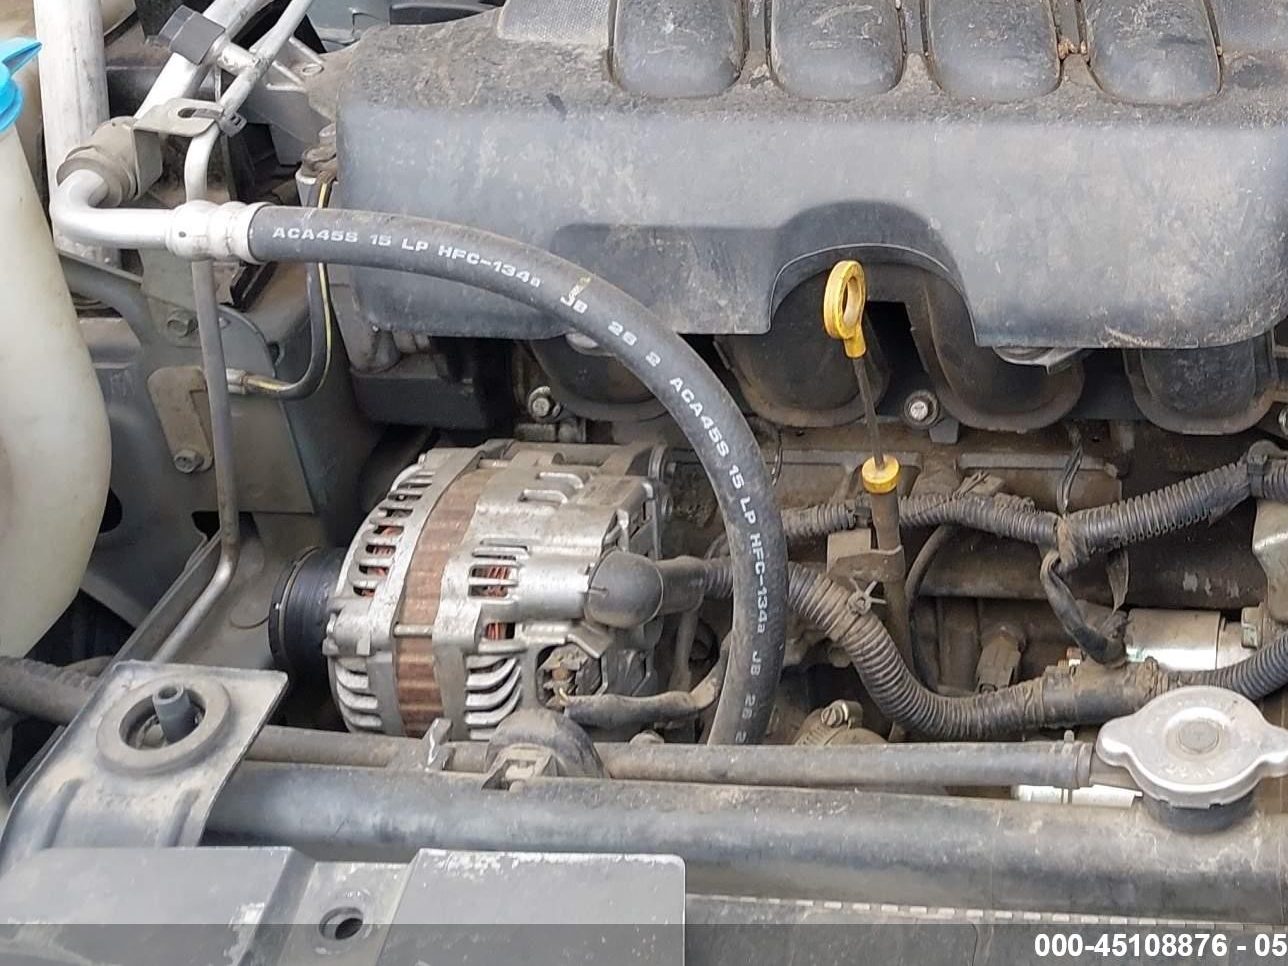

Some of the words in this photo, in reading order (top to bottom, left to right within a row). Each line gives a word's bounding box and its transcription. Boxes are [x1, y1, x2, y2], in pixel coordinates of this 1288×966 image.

[272, 227, 359, 244] ACA45S
[370, 233, 392, 247] 15
[401, 238, 429, 252] LP
[438, 244, 542, 288] HFC-134a
[645, 351, 661, 367] 2
[669, 377, 730, 457] ACA45S
[729, 464, 745, 489] 15
[740, 496, 757, 524] LP
[750, 533, 768, 634] HFC-134a
[750, 650, 762, 675] JB
